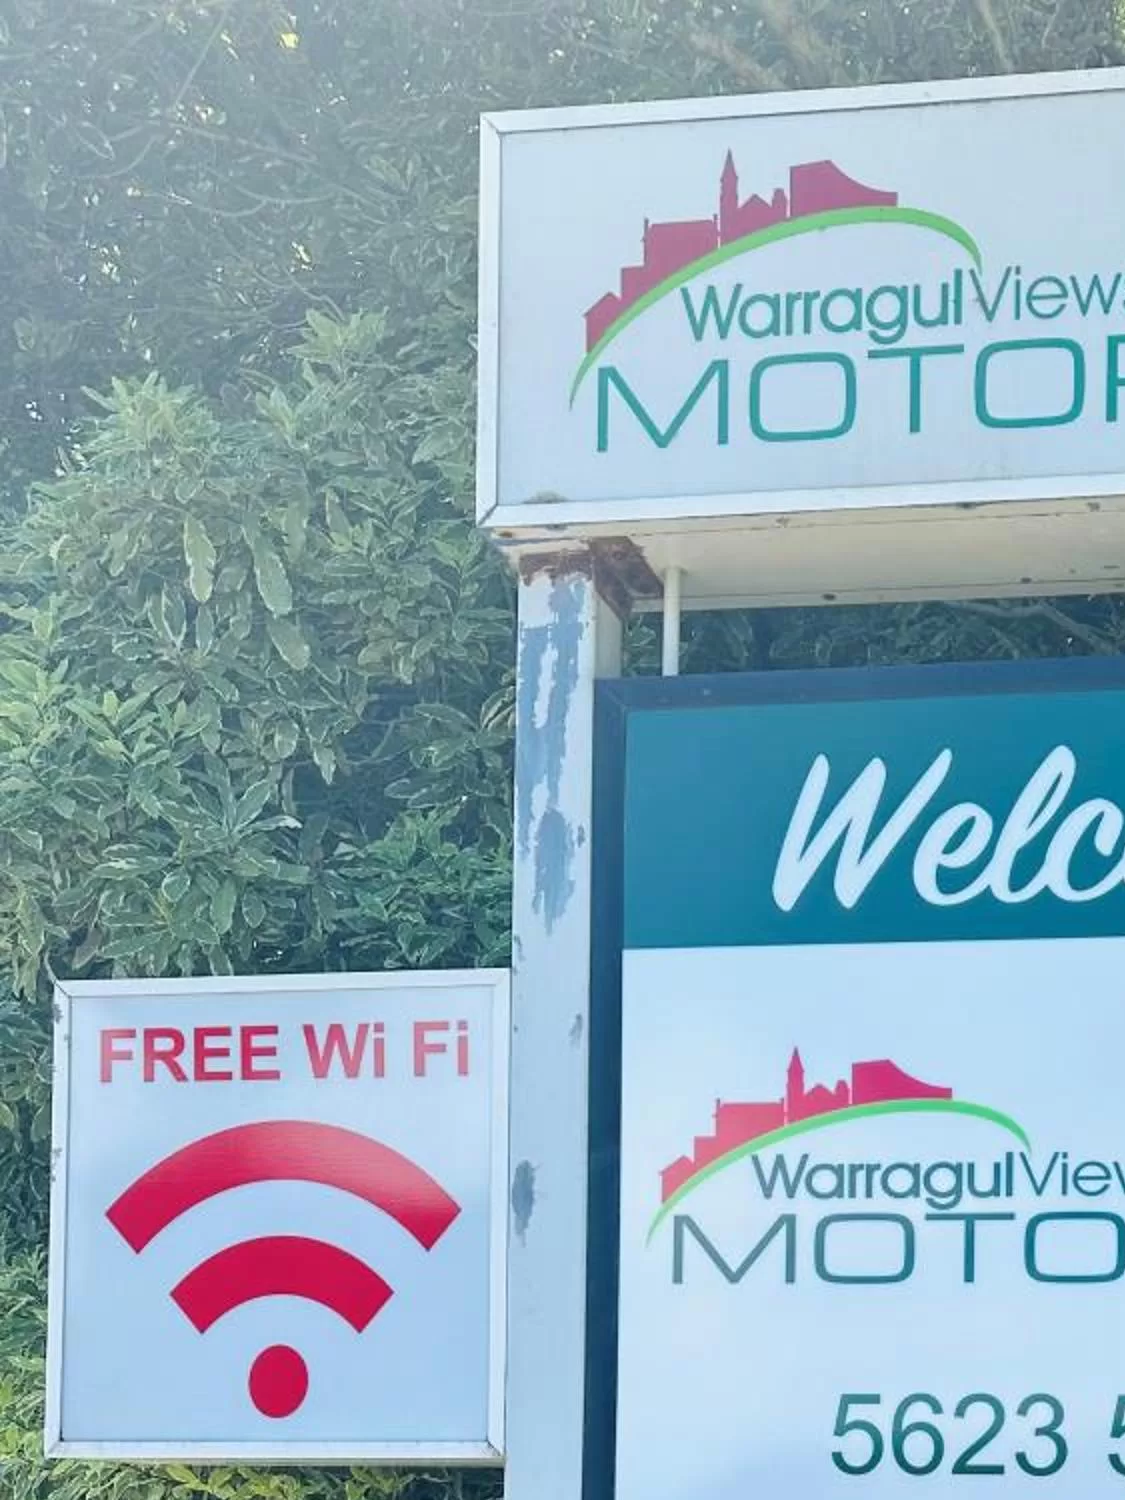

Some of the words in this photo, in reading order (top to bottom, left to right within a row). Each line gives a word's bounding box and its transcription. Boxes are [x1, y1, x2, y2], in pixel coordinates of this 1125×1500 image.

[99, 1025, 281, 1083] FREE
[303, 1021, 386, 1079] Wi
[412, 1019, 470, 1077] Fi
[830, 1393, 1068, 1478] 5623
